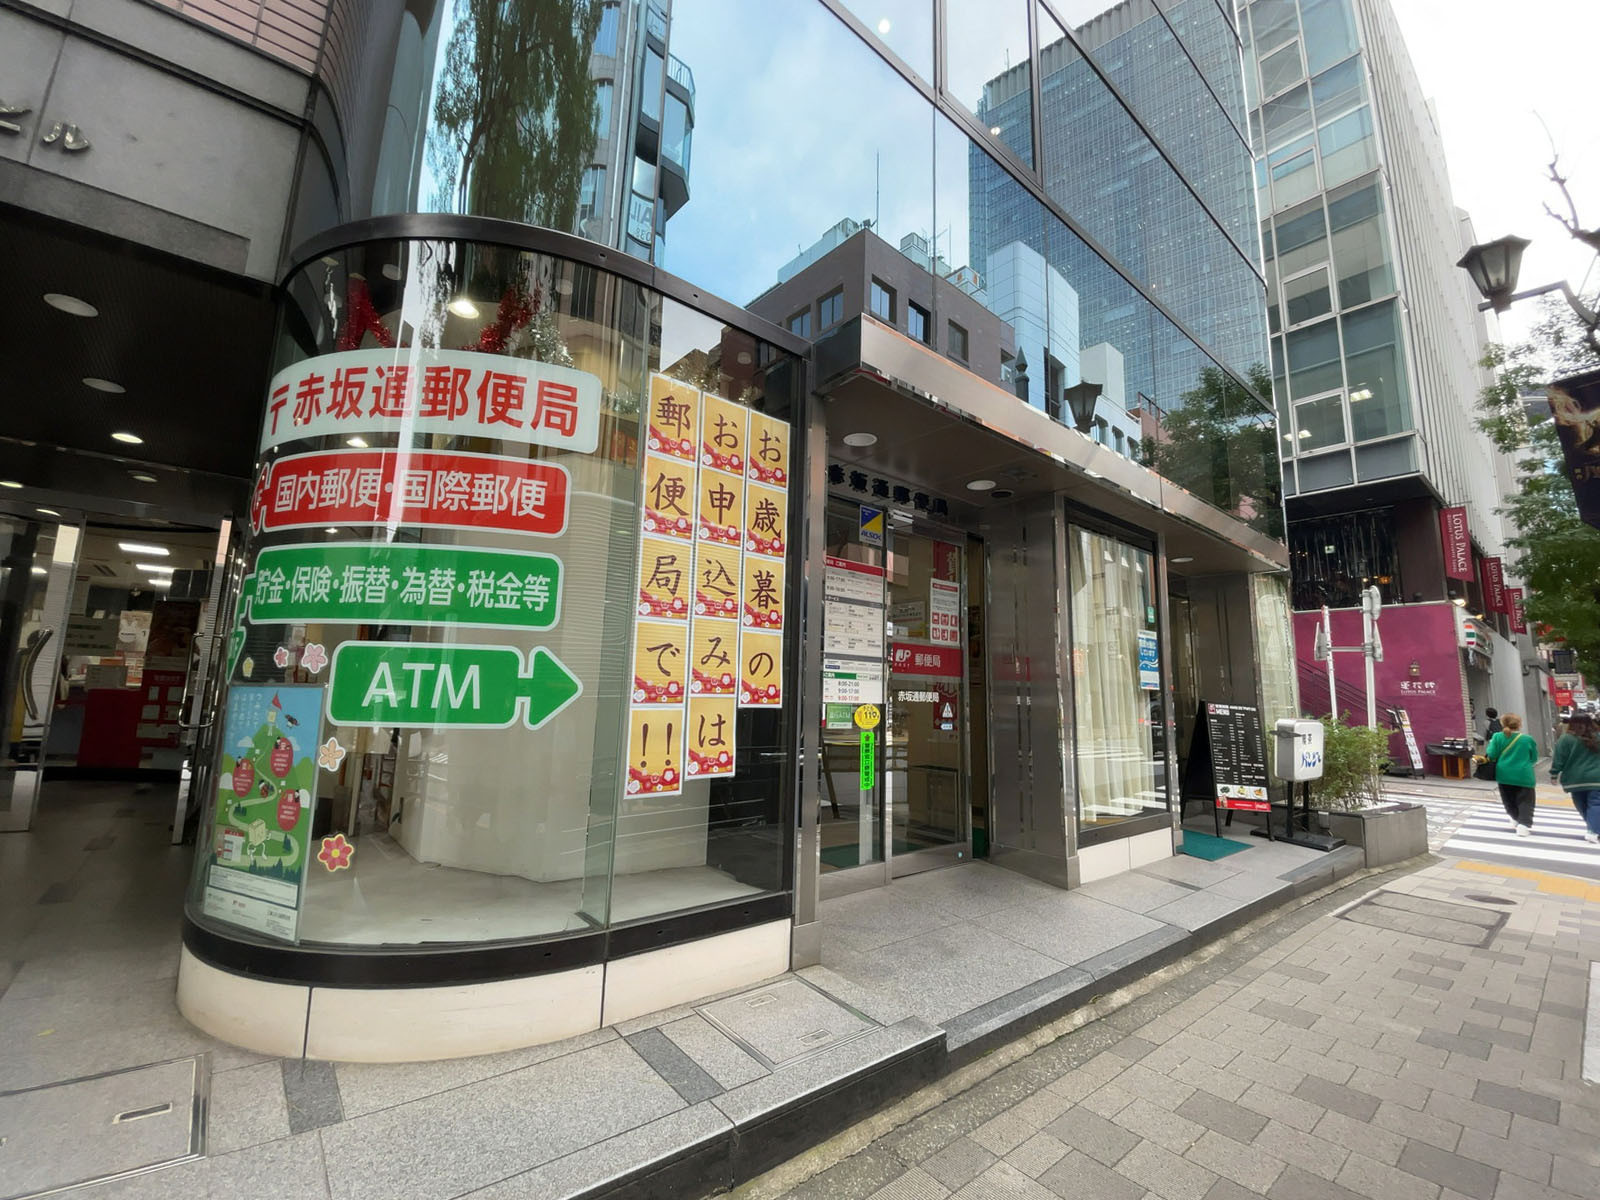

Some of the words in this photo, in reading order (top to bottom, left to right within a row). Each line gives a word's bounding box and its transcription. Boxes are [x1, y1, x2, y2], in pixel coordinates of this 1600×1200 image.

[274, 466, 548, 520] 国内郵便・国際郵便
[1452, 513, 1465, 540] LOTUS
[749, 430, 783, 679] お歳暮の
[1456, 542, 1468, 573] PALACE
[699, 413, 739, 748] お申込みは
[914, 653, 941, 668] 郵便局
[362, 661, 481, 710] ATM
